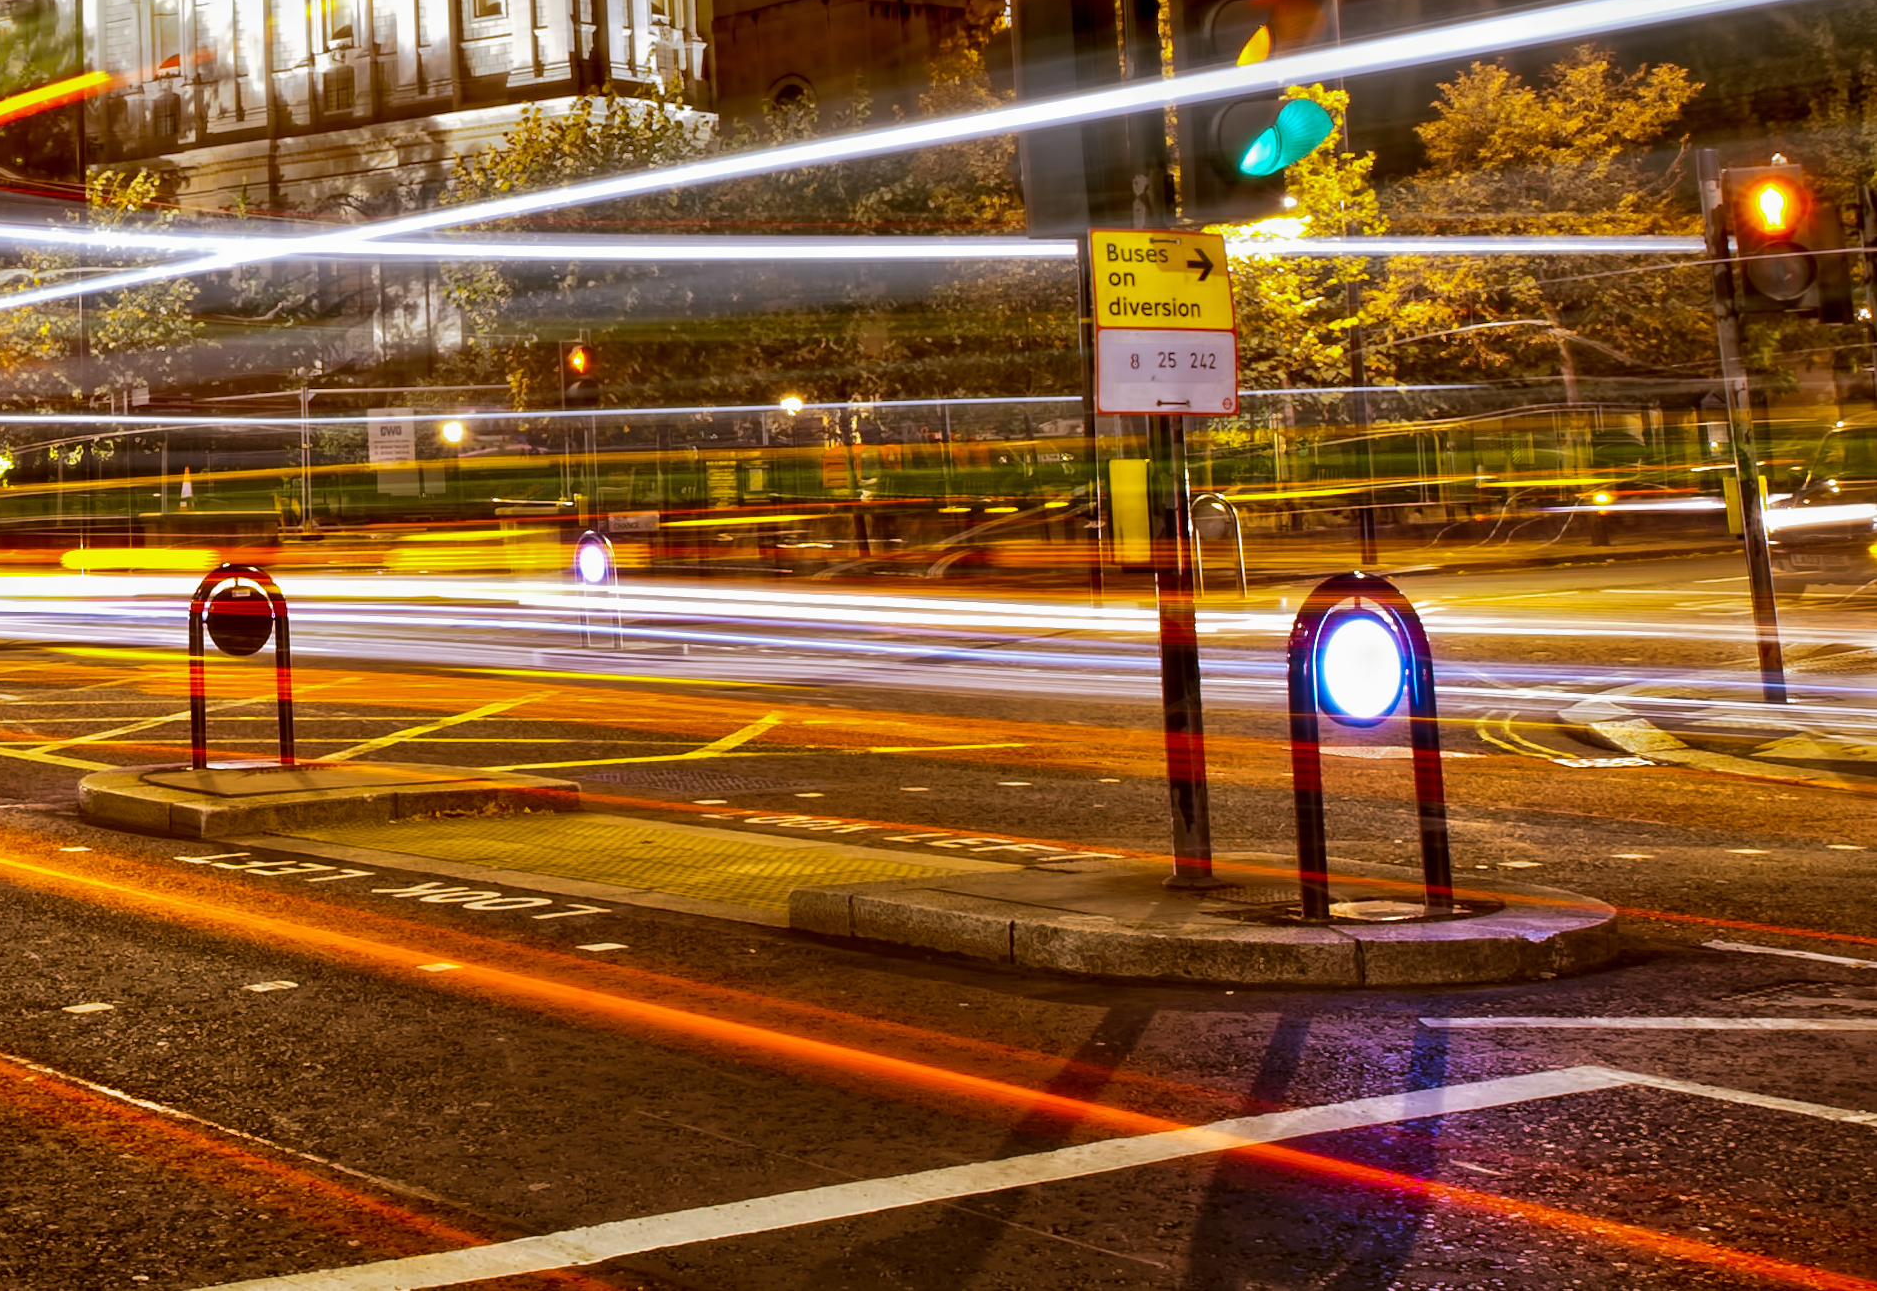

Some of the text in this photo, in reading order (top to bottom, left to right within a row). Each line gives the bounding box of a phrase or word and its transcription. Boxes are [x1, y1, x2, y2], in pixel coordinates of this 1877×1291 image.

[1106, 243, 1170, 264] Buses
[1109, 272, 1136, 287] on
[1109, 297, 1202, 318] diversion
[1130, 352, 1217, 370] 8 25 242
[700, 810, 1126, 862] LOOK LEFT
[173, 852, 612, 920] LOOK LEFT
